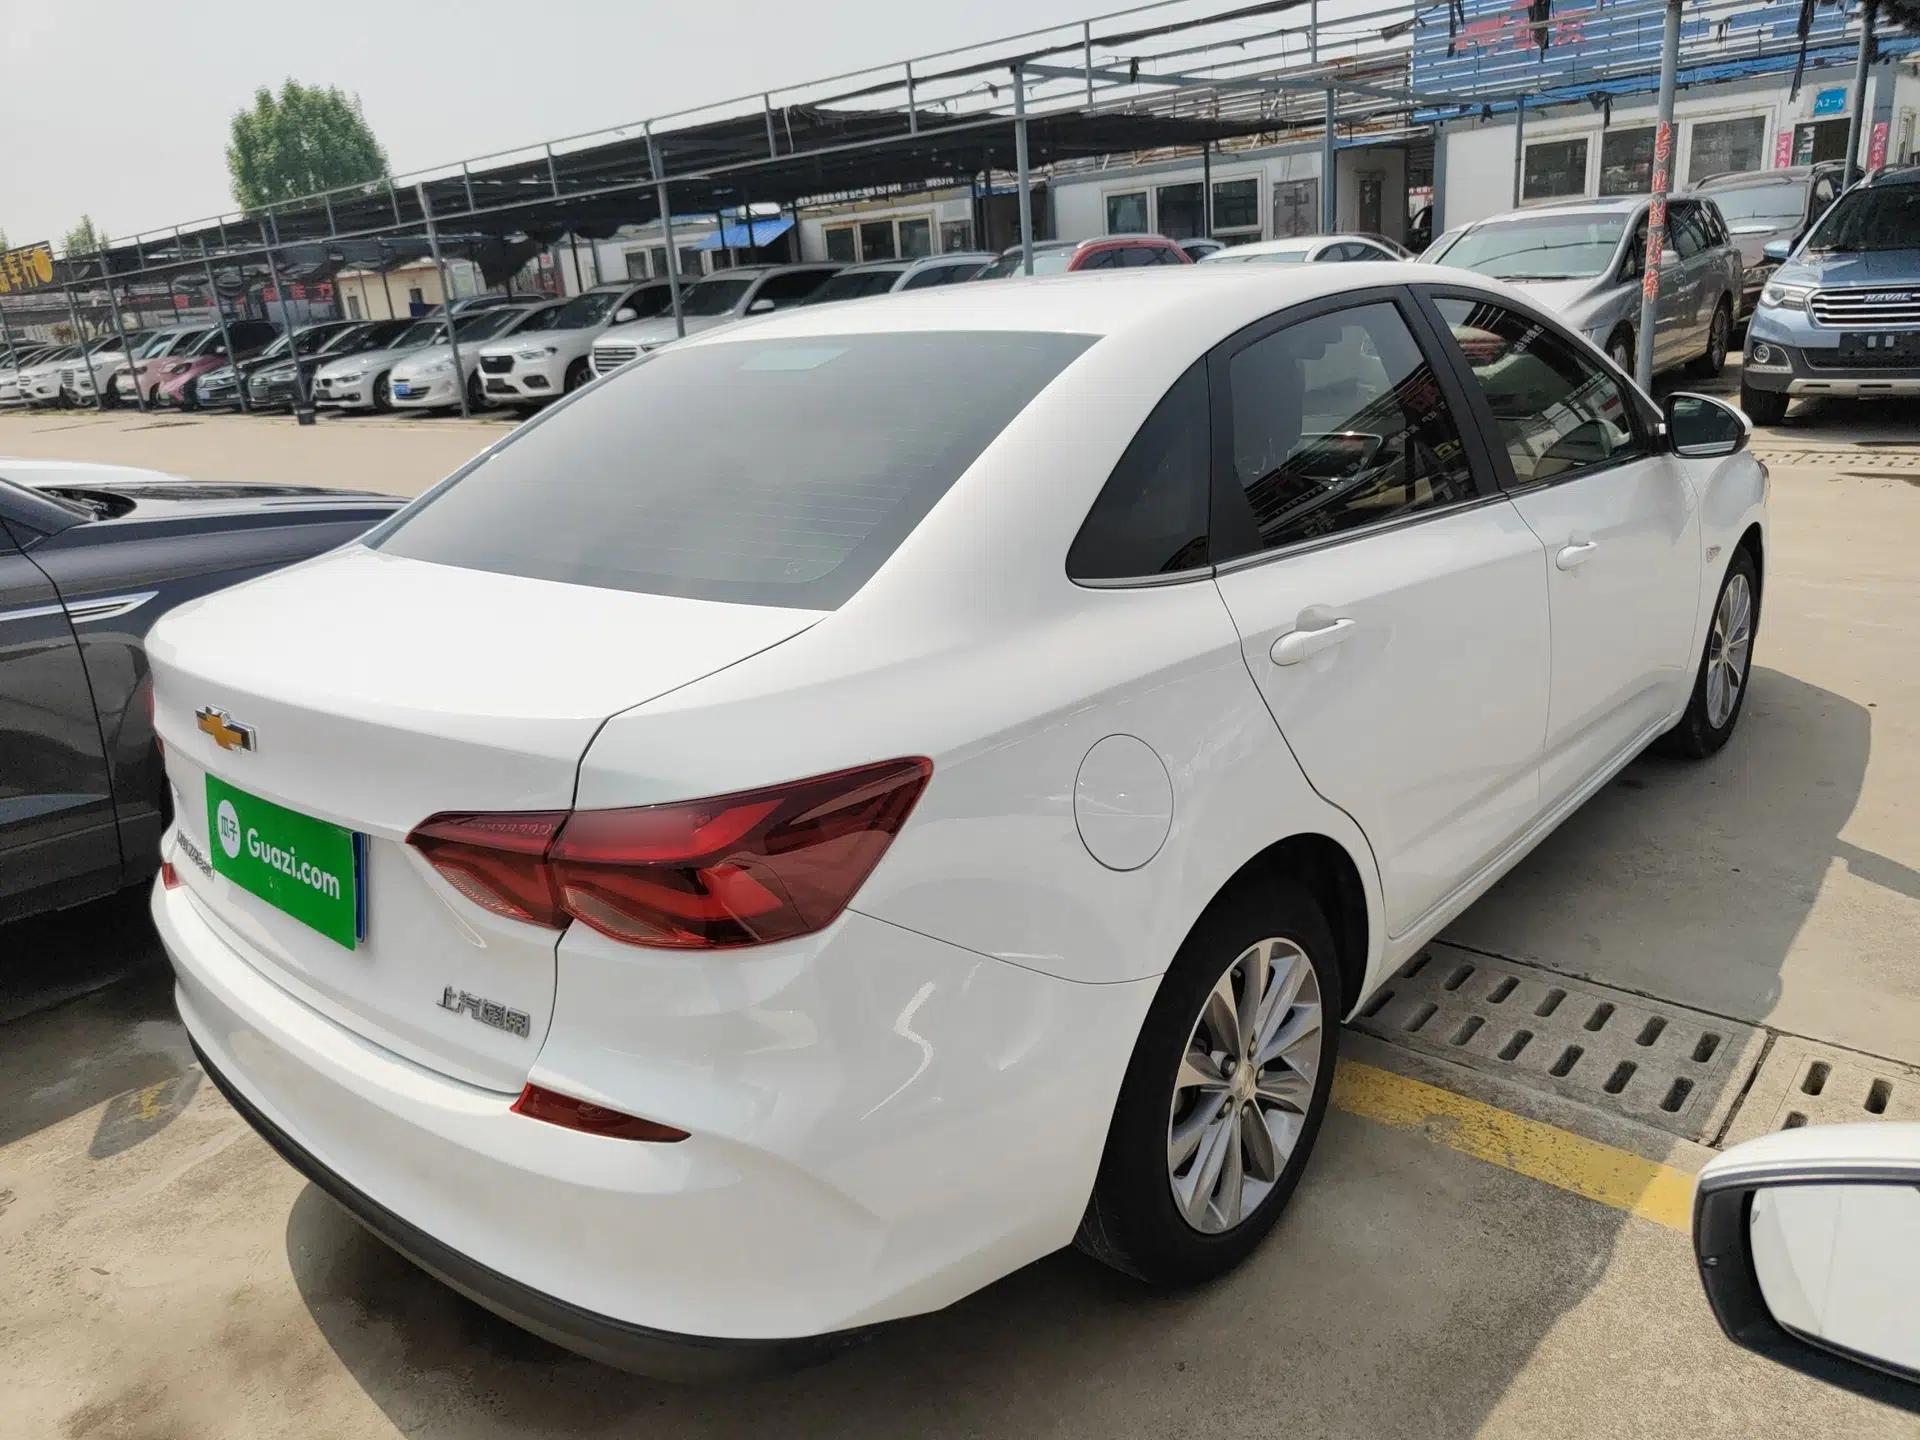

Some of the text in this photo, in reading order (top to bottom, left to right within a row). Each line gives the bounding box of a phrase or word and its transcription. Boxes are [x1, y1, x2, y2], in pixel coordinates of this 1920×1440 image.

[1864, 293, 1912, 303] HAVAL
[221, 815, 238, 843] 瓜子
[247, 828, 340, 900] Guazi.com
